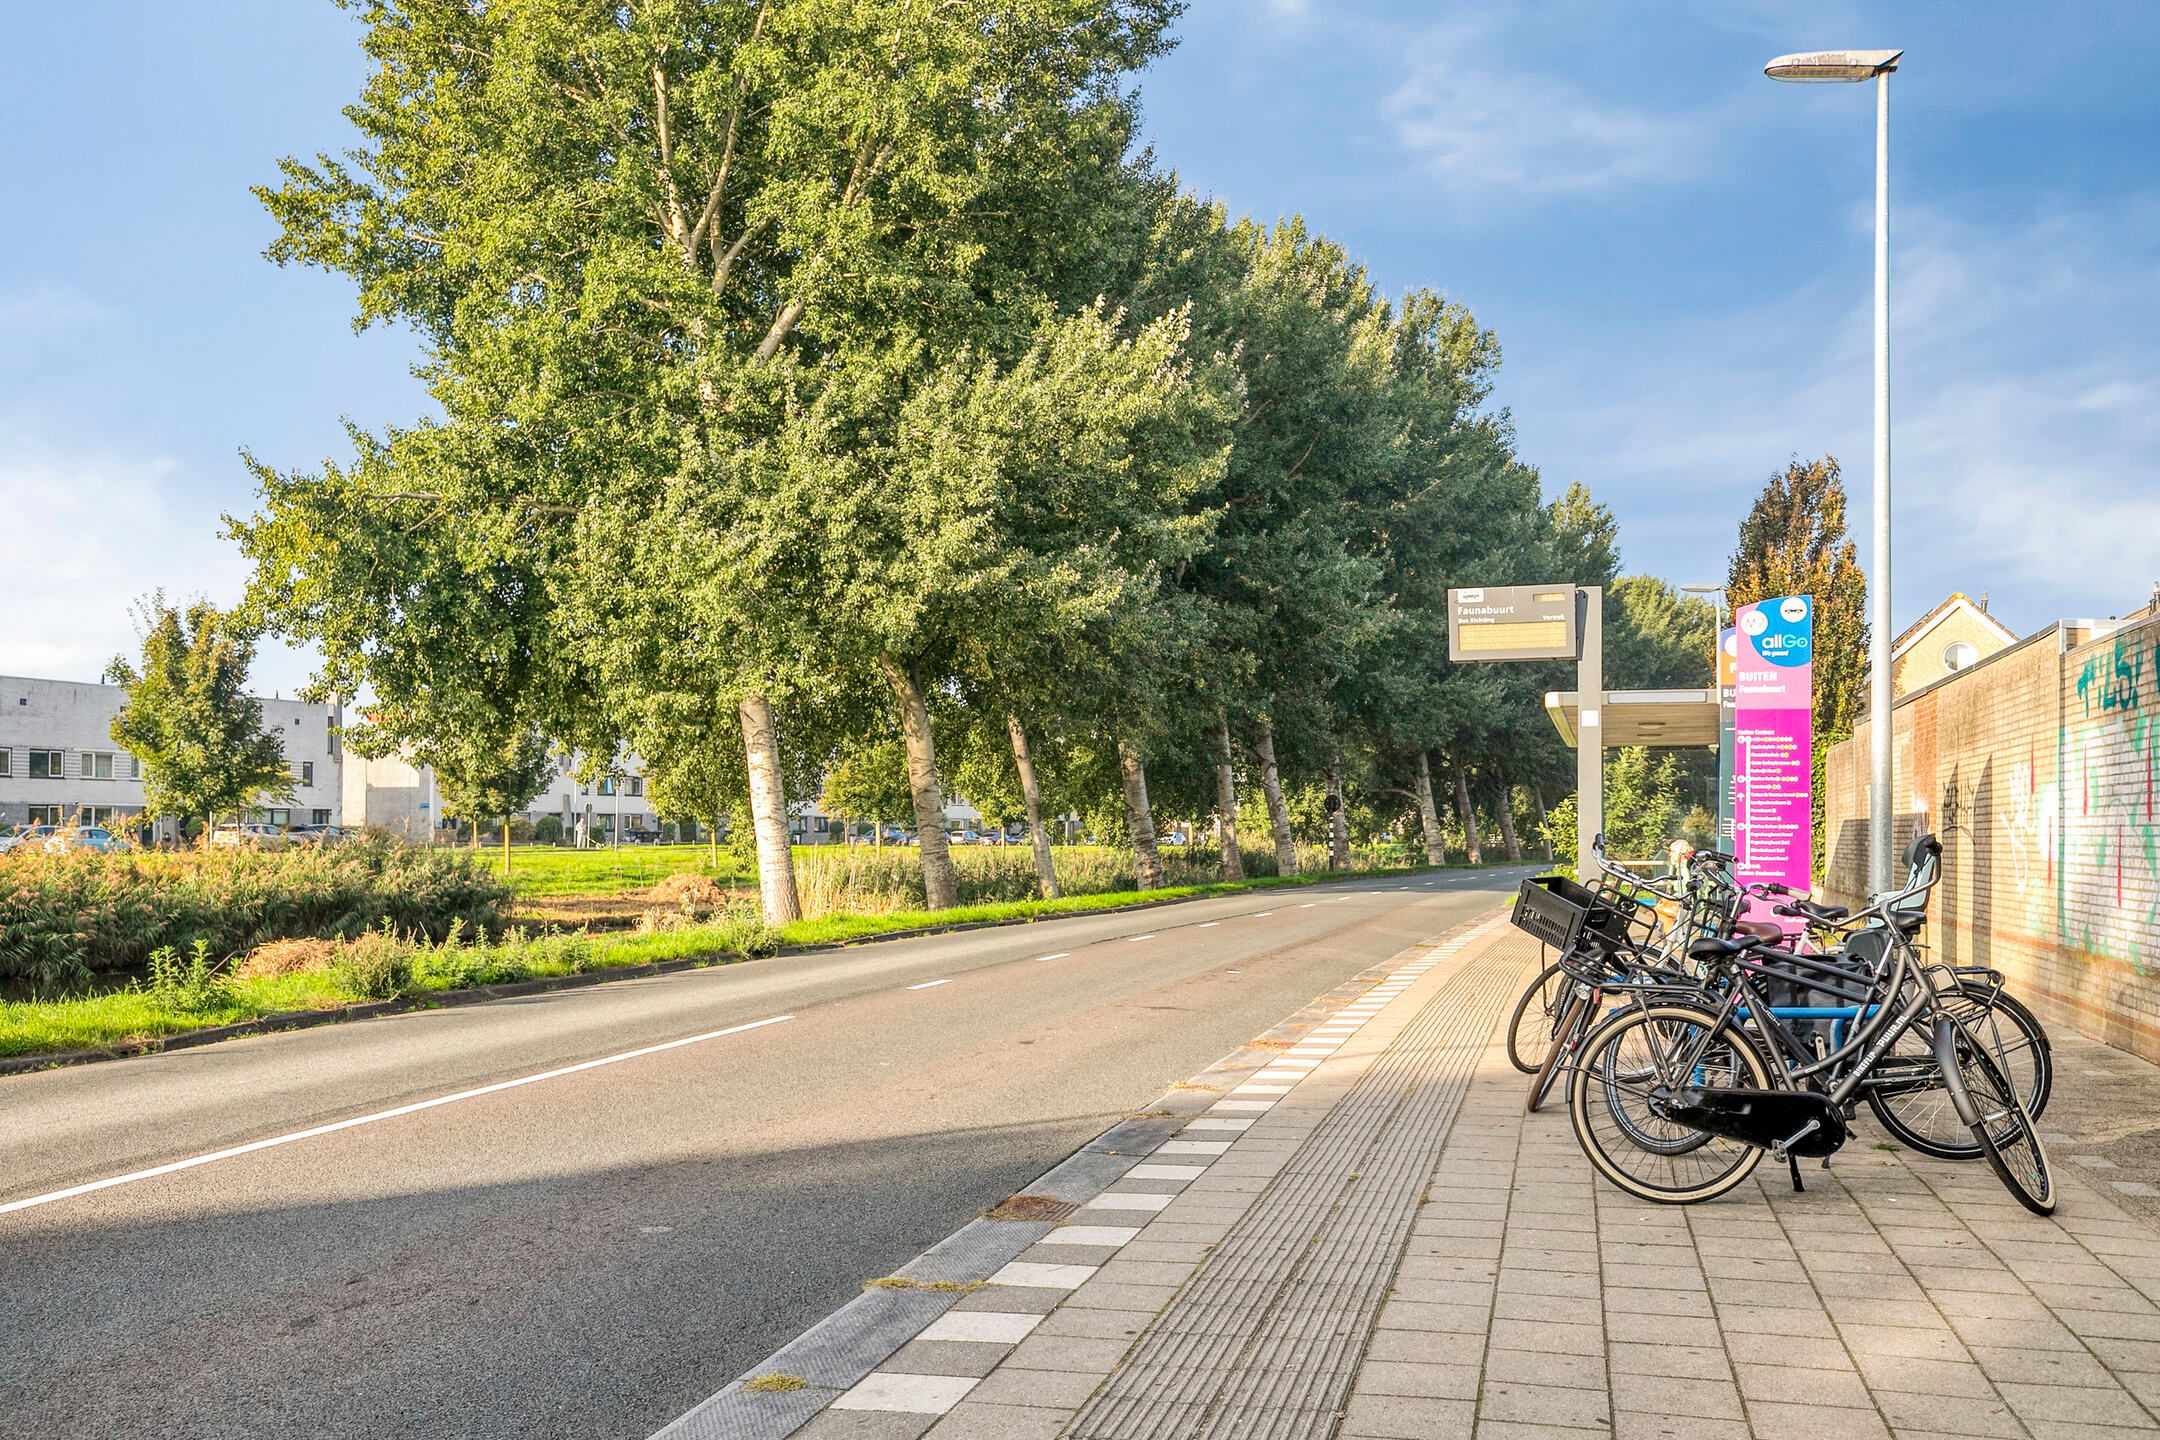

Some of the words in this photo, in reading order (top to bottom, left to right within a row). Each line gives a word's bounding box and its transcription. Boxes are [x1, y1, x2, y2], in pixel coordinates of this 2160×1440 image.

[1457, 606, 1514, 615] Faunabuurt
[1761, 634, 1808, 649] allGo
[1739, 672, 1777, 681] BUITEN
